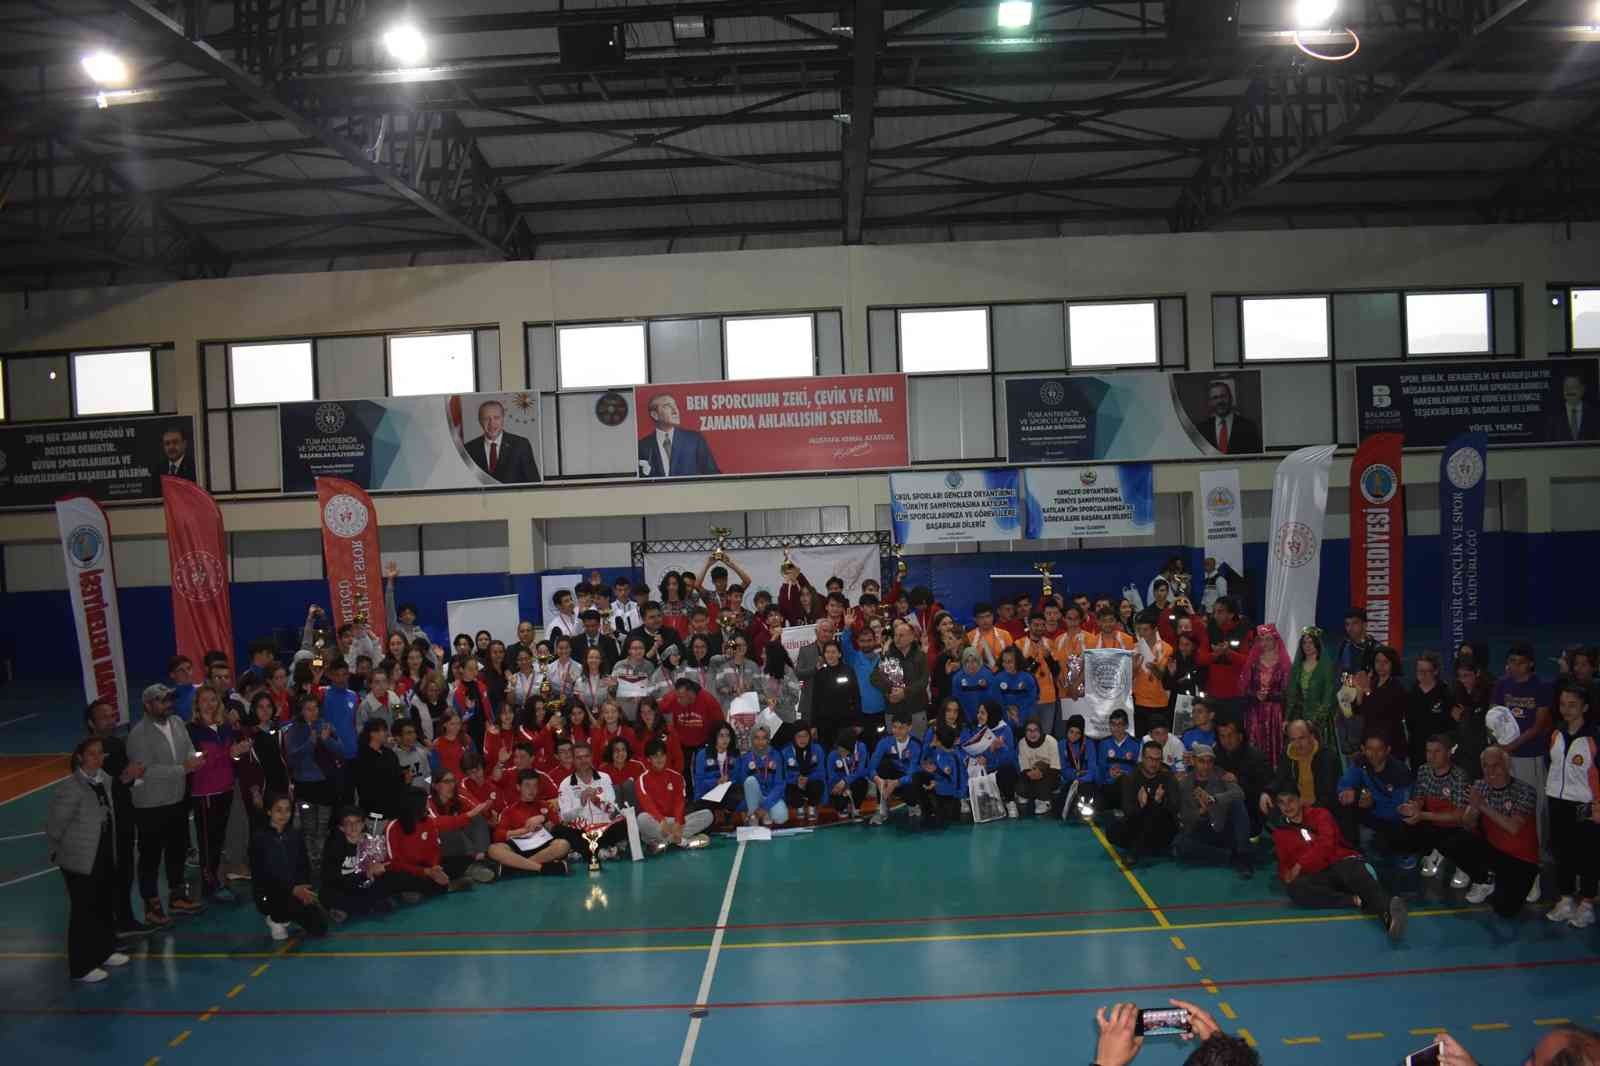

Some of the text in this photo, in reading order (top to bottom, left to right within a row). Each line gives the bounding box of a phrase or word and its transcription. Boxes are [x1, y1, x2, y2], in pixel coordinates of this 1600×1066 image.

[687, 385, 894, 411] BEN SPORCUNUN ZEKİ, ÇEVİK VE AYNI
[699, 405, 882, 431] ZAMANDA AHLAKLISINI SEVERİM.
[125, 427, 135, 438] VE
[1495, 423, 1523, 432] YILMAZ
[913, 492, 943, 500] SPORLARI
[944, 490, 972, 499] GENÇLER
[903, 501, 928, 510] TÜRKİYE
[982, 499, 1009, 507] KATILAN
[1042, 506, 1065, 514] KATILAN
[1451, 491, 1463, 523] SPOR
[910, 511, 963, 520] SPORCULARIMIZA
[926, 520, 986, 530] BAŞARILAR DİLERİZ
[1361, 508, 1390, 595] BELEDİYESİ
